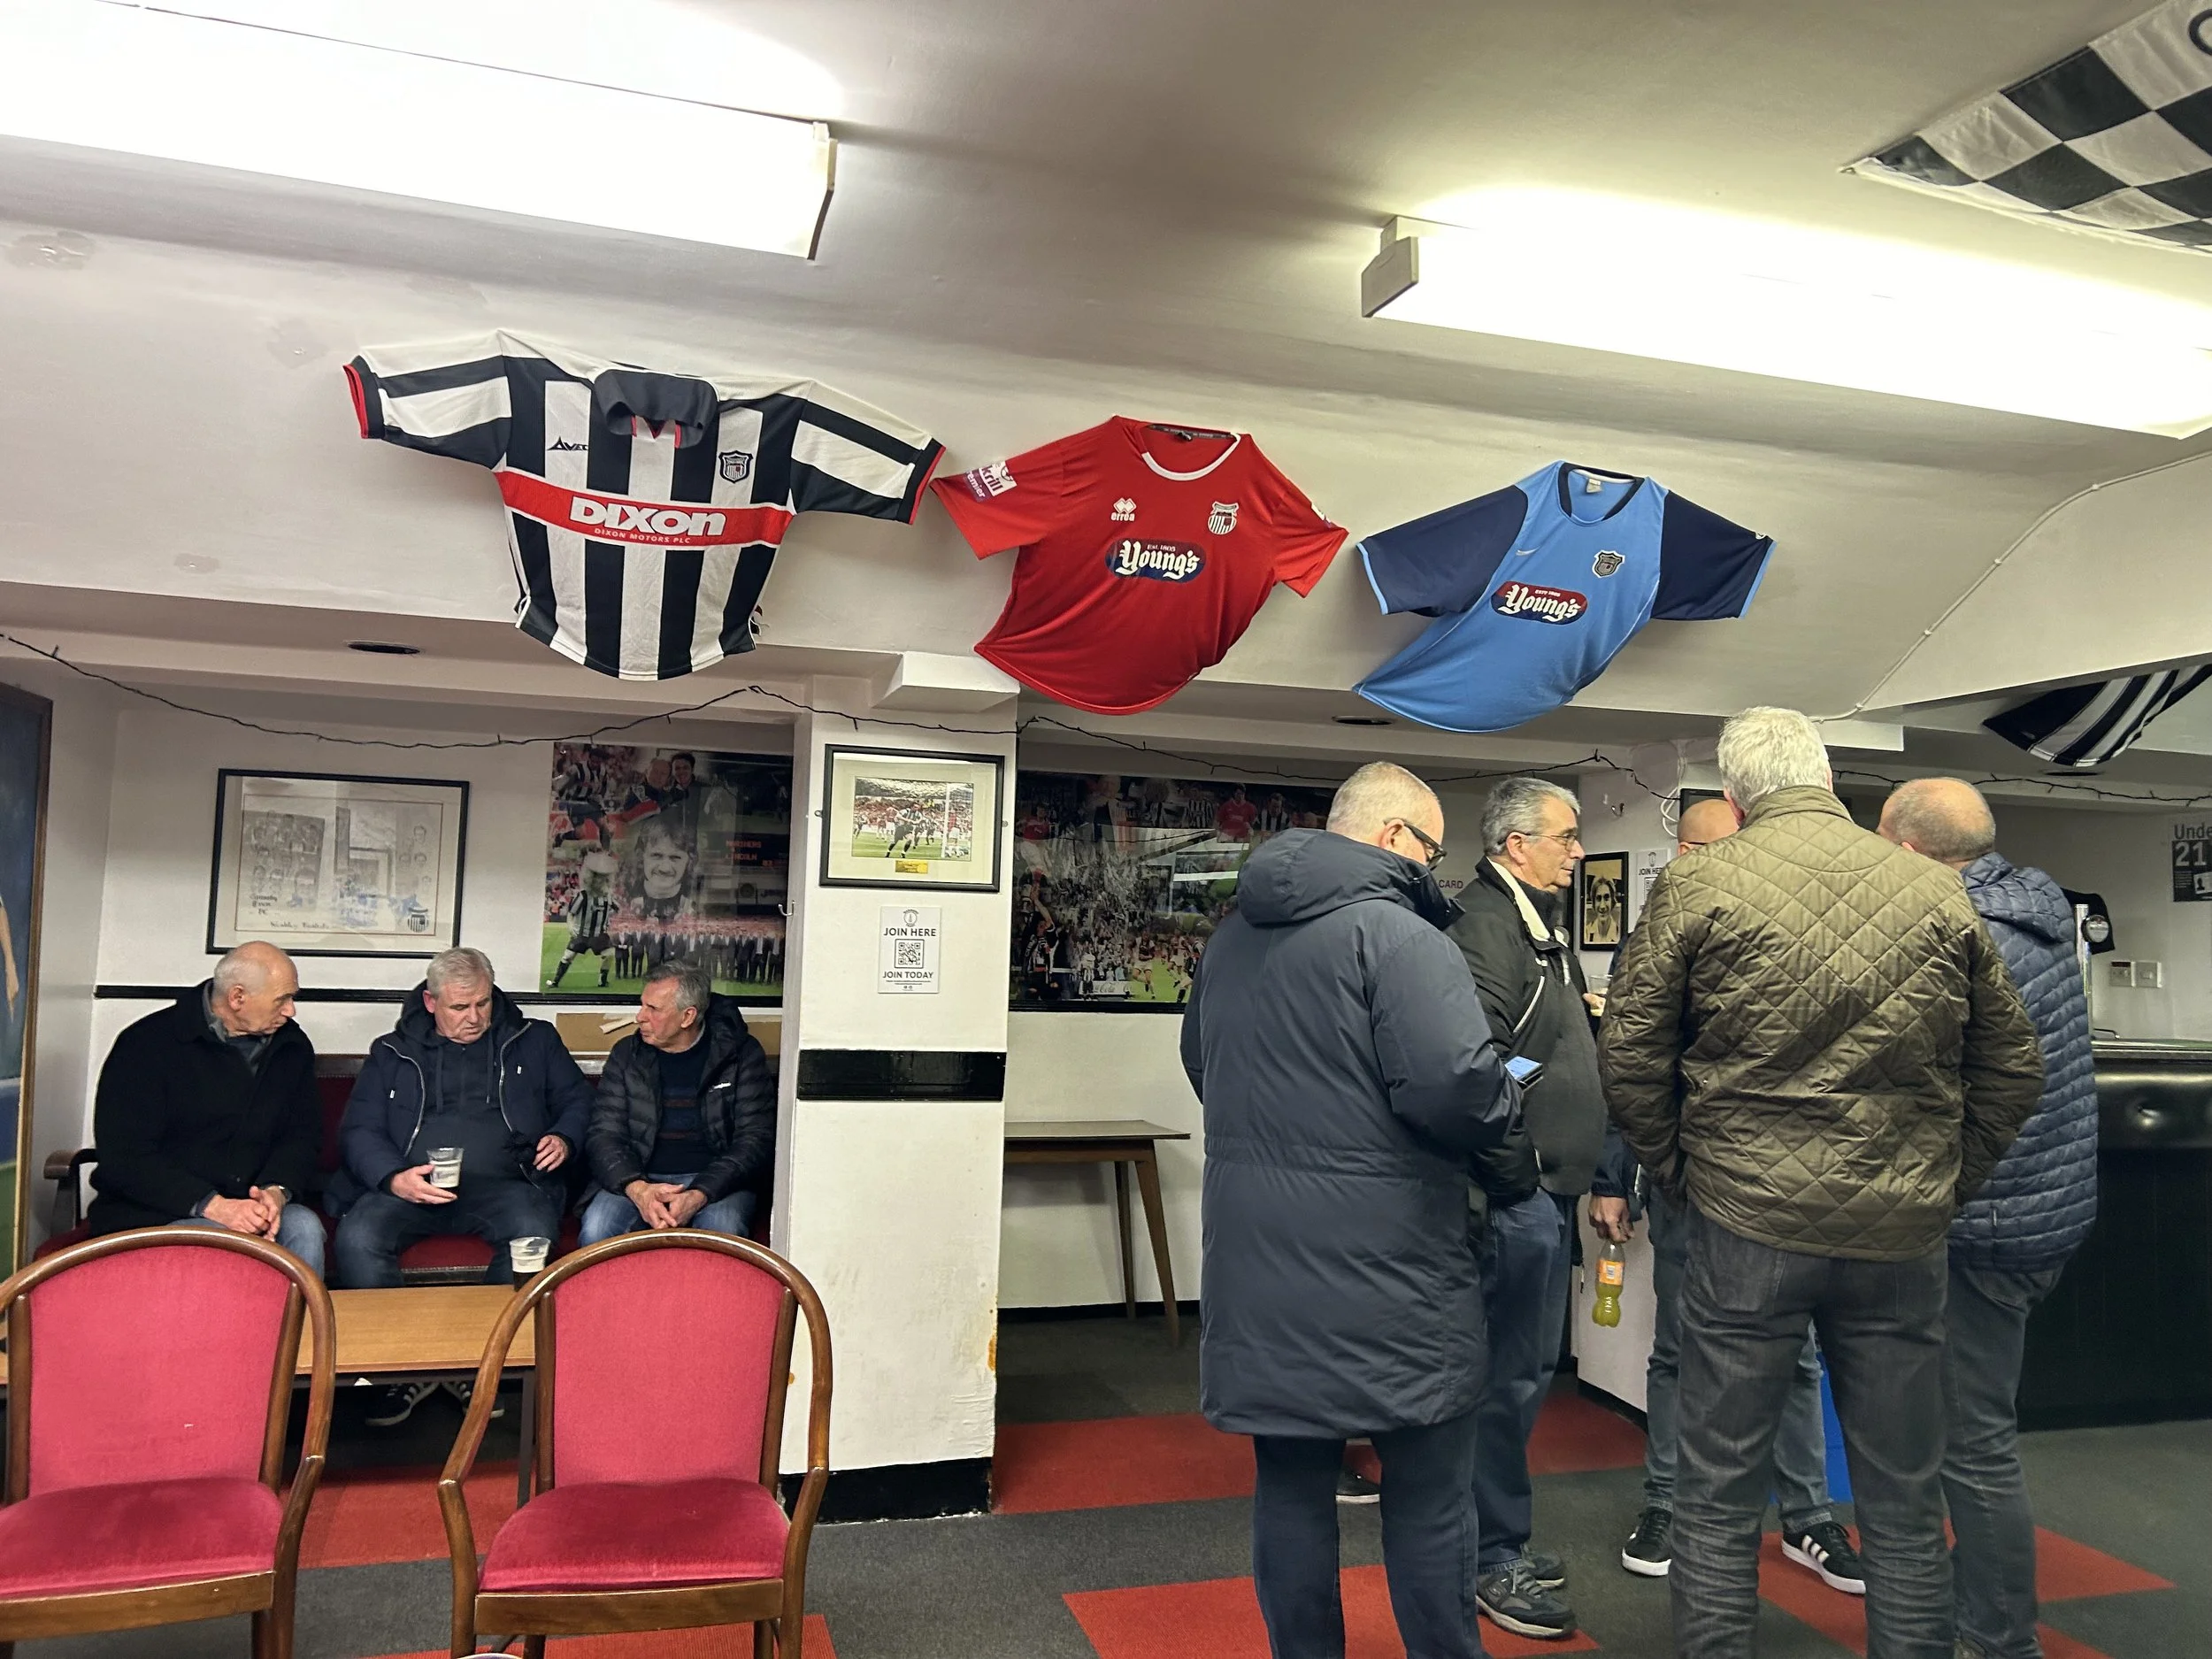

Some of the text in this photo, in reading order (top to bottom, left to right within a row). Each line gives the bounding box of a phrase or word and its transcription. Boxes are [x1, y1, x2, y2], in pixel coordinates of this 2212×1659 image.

[965, 471, 985, 497] remier
[981, 465, 1003, 491] krill
[595, 528, 626, 539] DIXON
[630, 534, 670, 543] MOTORS
[1116, 540, 1200, 580] Young's
[1498, 584, 1581, 622] Young's
[2174, 822, 2212, 840] Unde
[1439, 879, 1463, 889] CARD
[884, 927, 936, 937] JOIN HERE
